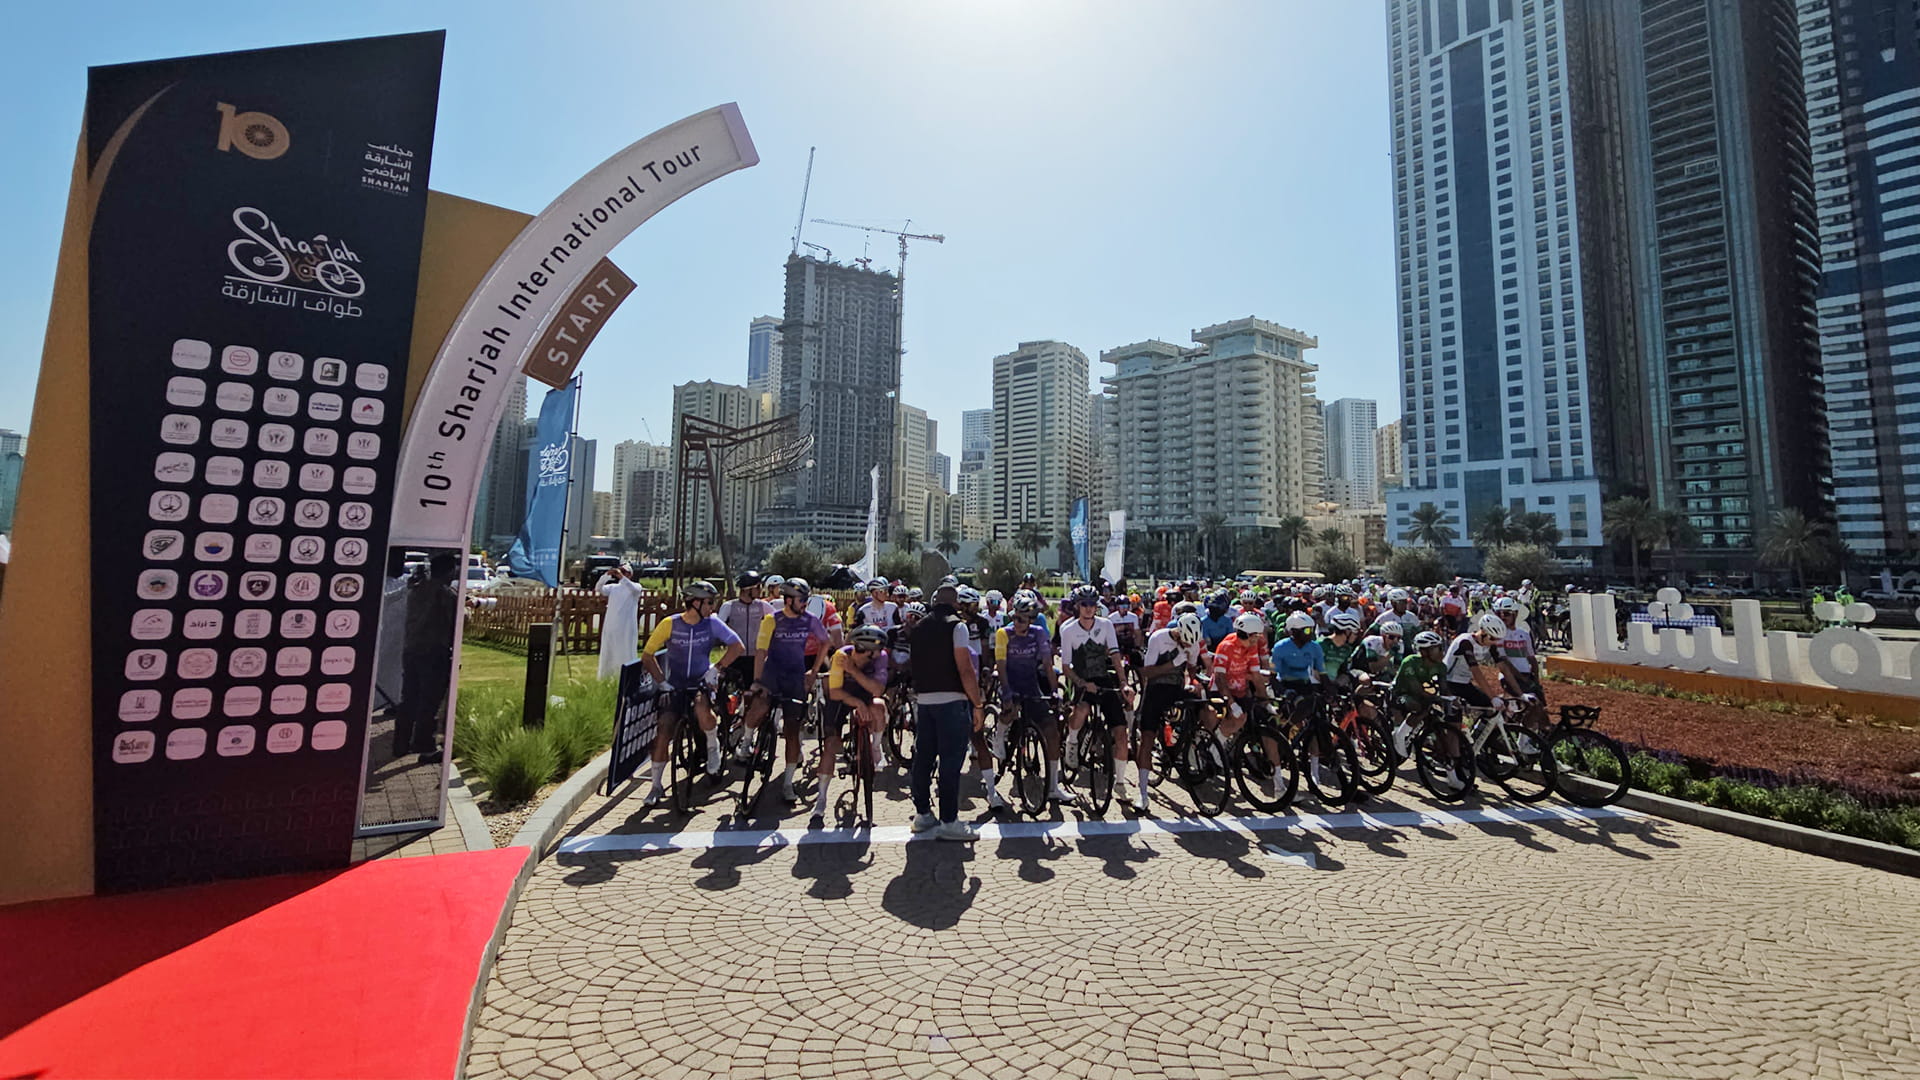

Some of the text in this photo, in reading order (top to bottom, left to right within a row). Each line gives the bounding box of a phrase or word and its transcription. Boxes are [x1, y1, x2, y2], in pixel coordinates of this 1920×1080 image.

[216, 101, 290, 160] 10
[364, 151, 412, 171] الشارقة
[367, 143, 414, 158] مجلس
[361, 176, 409, 193] SHARJAH
[362, 166, 411, 183] الرياضي
[221, 281, 363, 319] طواف الشارقة
[419, 145, 701, 508] 10th Sharjah International Tour
[547, 278, 617, 366] START
